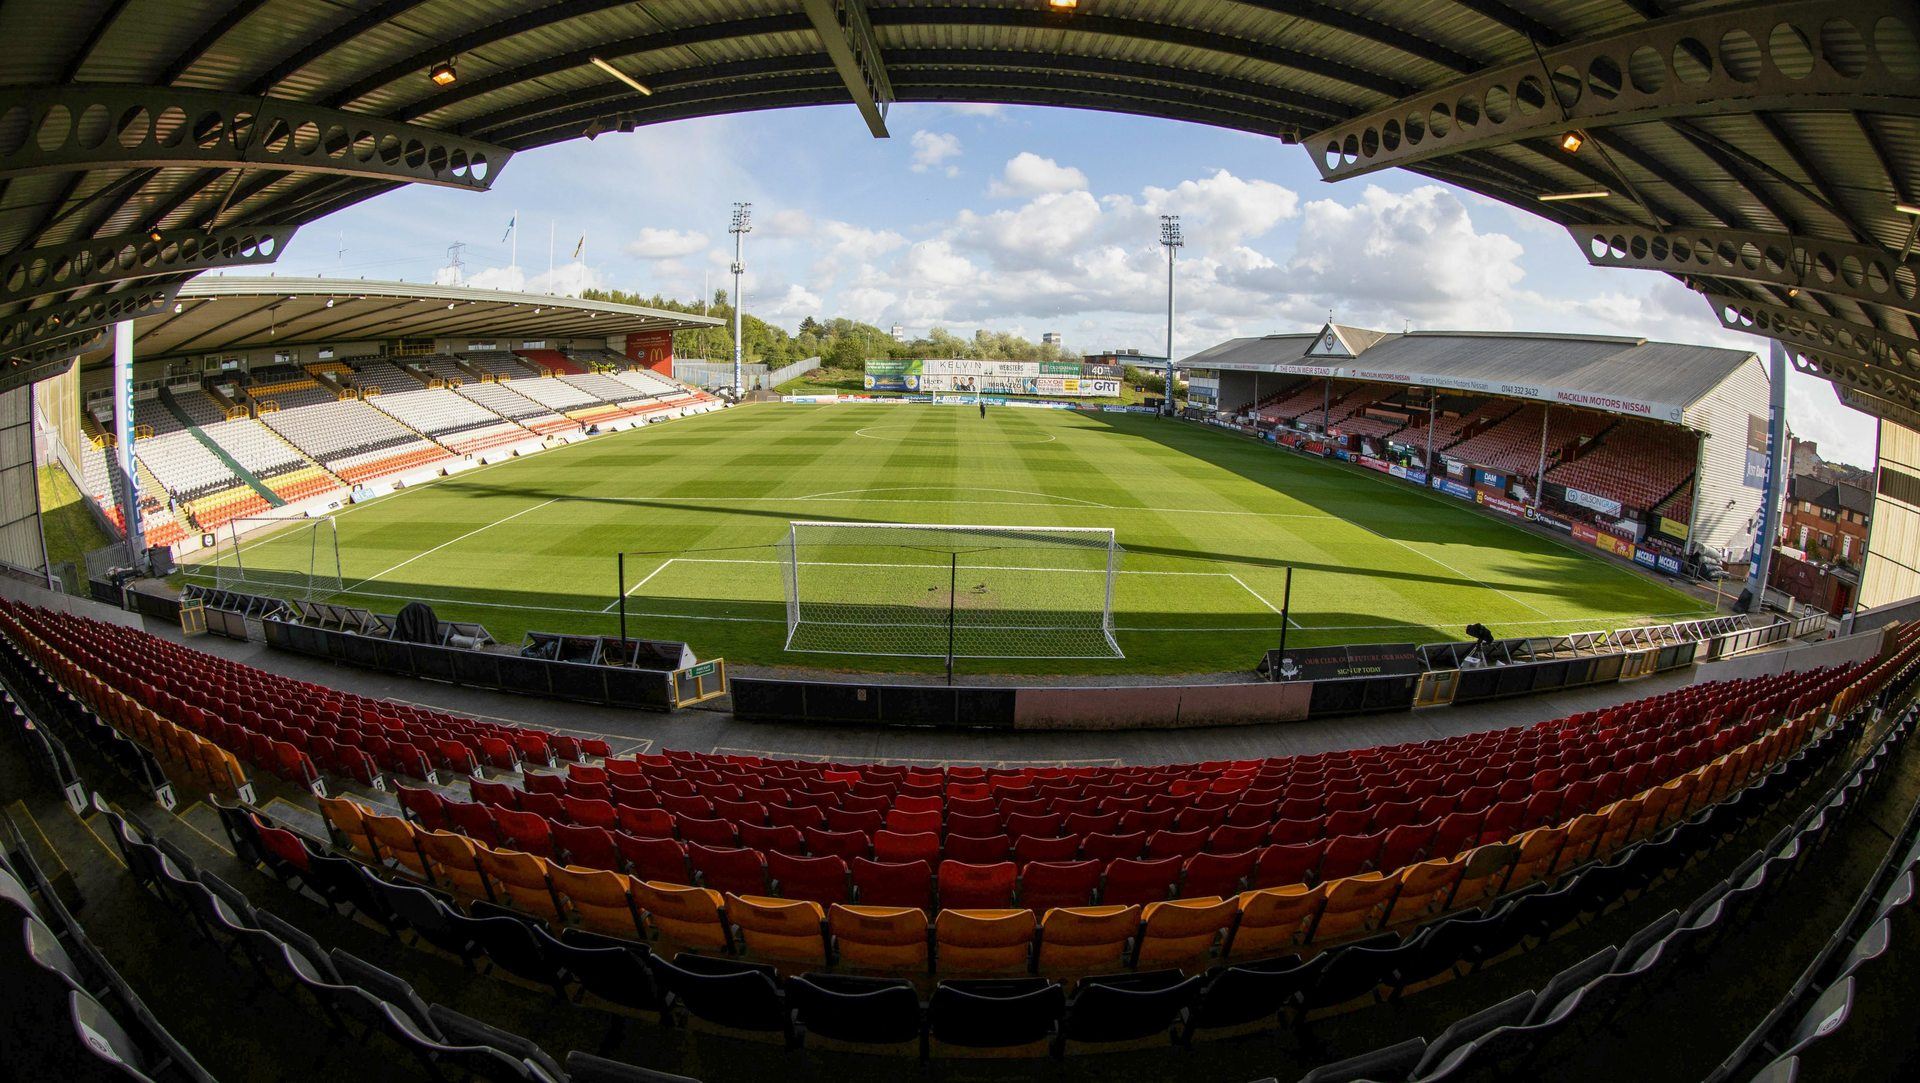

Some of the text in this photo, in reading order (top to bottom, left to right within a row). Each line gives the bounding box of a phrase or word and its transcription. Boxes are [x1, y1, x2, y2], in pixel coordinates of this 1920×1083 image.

[939, 361, 982, 369] KELVIN
[1091, 366, 1104, 375] 40
[1314, 367, 1330, 375] STAND
[1093, 382, 1118, 392] GRT
[1453, 379, 1470, 388] Motors
[1471, 381, 1489, 390] Nissan
[1501, 384, 1539, 397] 0141 332 3432
[1557, 391, 1651, 414] MACKLIN MOTORS NISSAN
[1484, 472, 1497, 483] DAM
[161, 790, 173, 807] K
